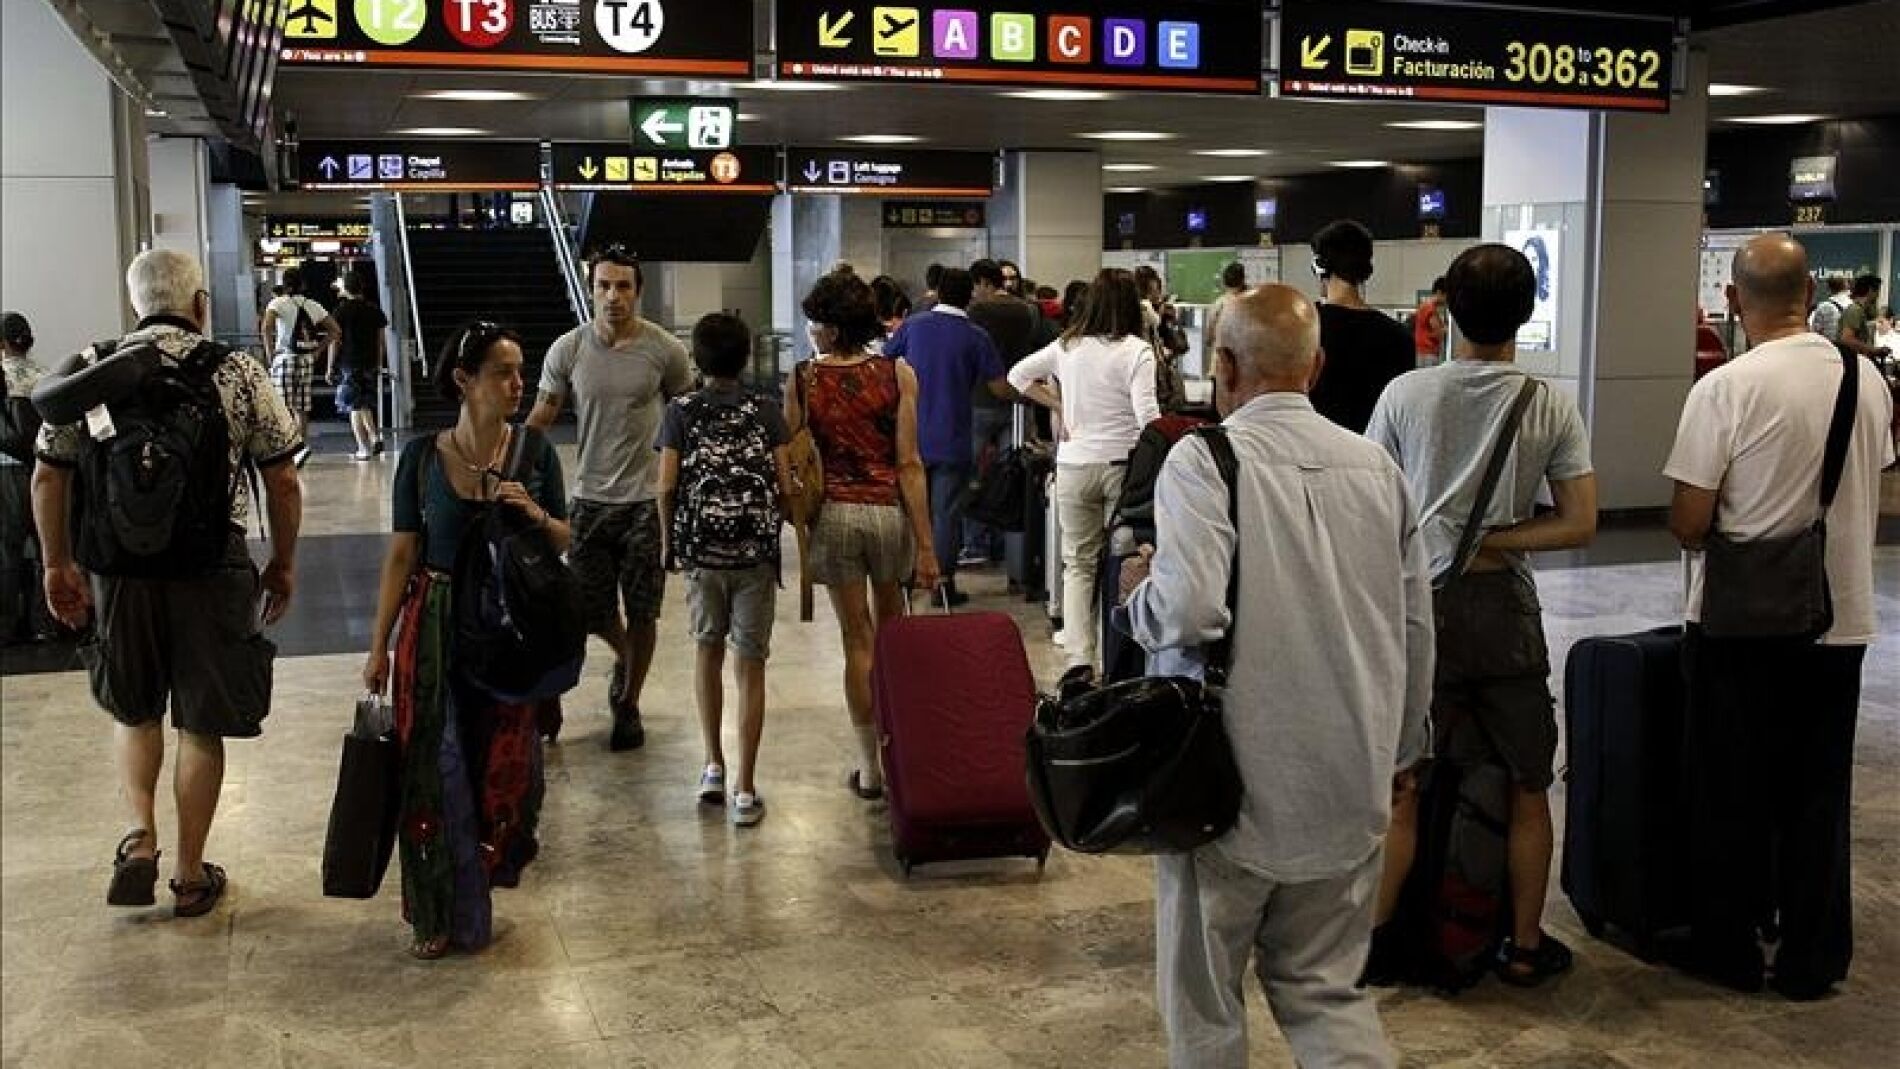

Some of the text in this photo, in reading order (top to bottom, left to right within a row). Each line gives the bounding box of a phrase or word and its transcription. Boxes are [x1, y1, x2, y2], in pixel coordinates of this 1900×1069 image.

[451, 0, 508, 34] T3
[531, 9, 557, 29] BUS
[603, 2, 655, 37] T4
[943, 19, 1188, 60] A B C D E
[1393, 34, 1450, 54] Check-in
[1393, 57, 1495, 81] Facturación
[1504, 41, 1660, 89] 308 to a 362
